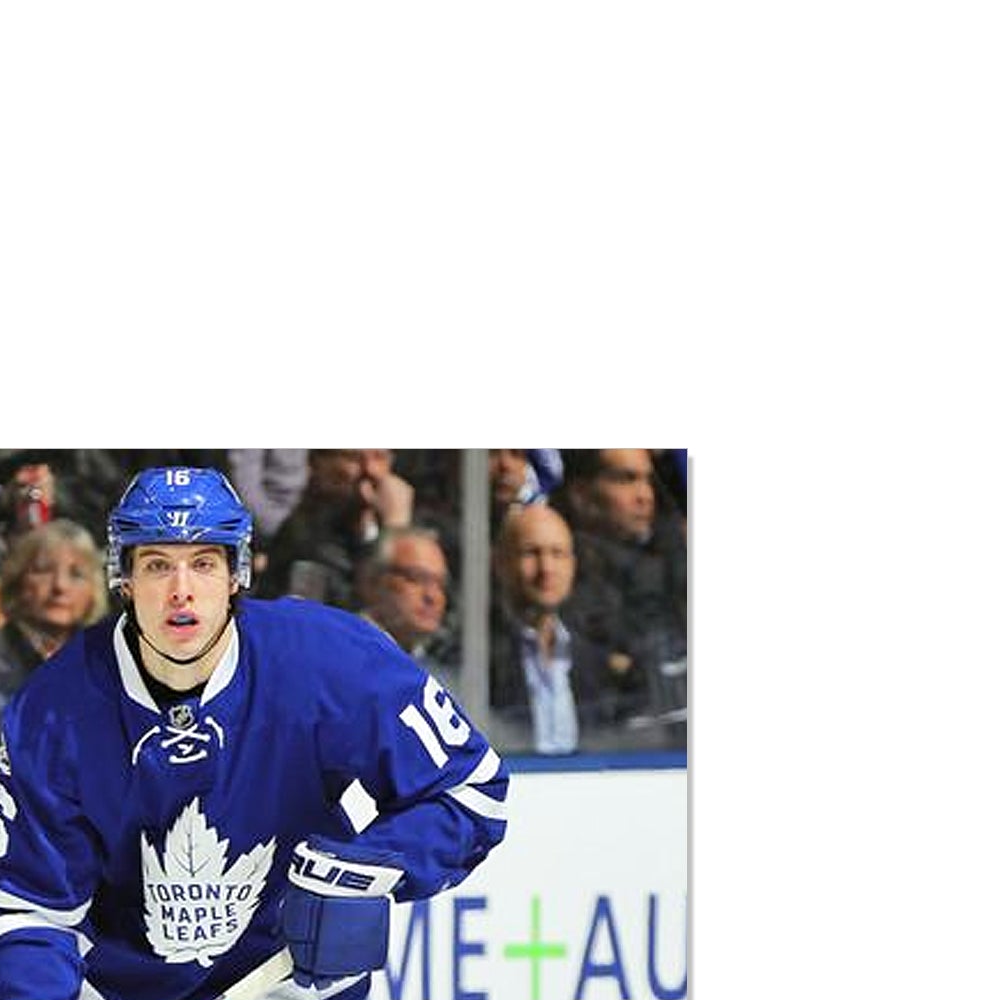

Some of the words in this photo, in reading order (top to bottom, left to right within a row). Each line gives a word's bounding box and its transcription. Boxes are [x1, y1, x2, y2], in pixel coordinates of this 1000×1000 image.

[166, 470, 190, 486] 16
[399, 674, 471, 769] 16
[147, 883, 252, 903] TORONTO
[161, 902, 237, 924] MAPLE
[163, 918, 239, 942] LEAFS
